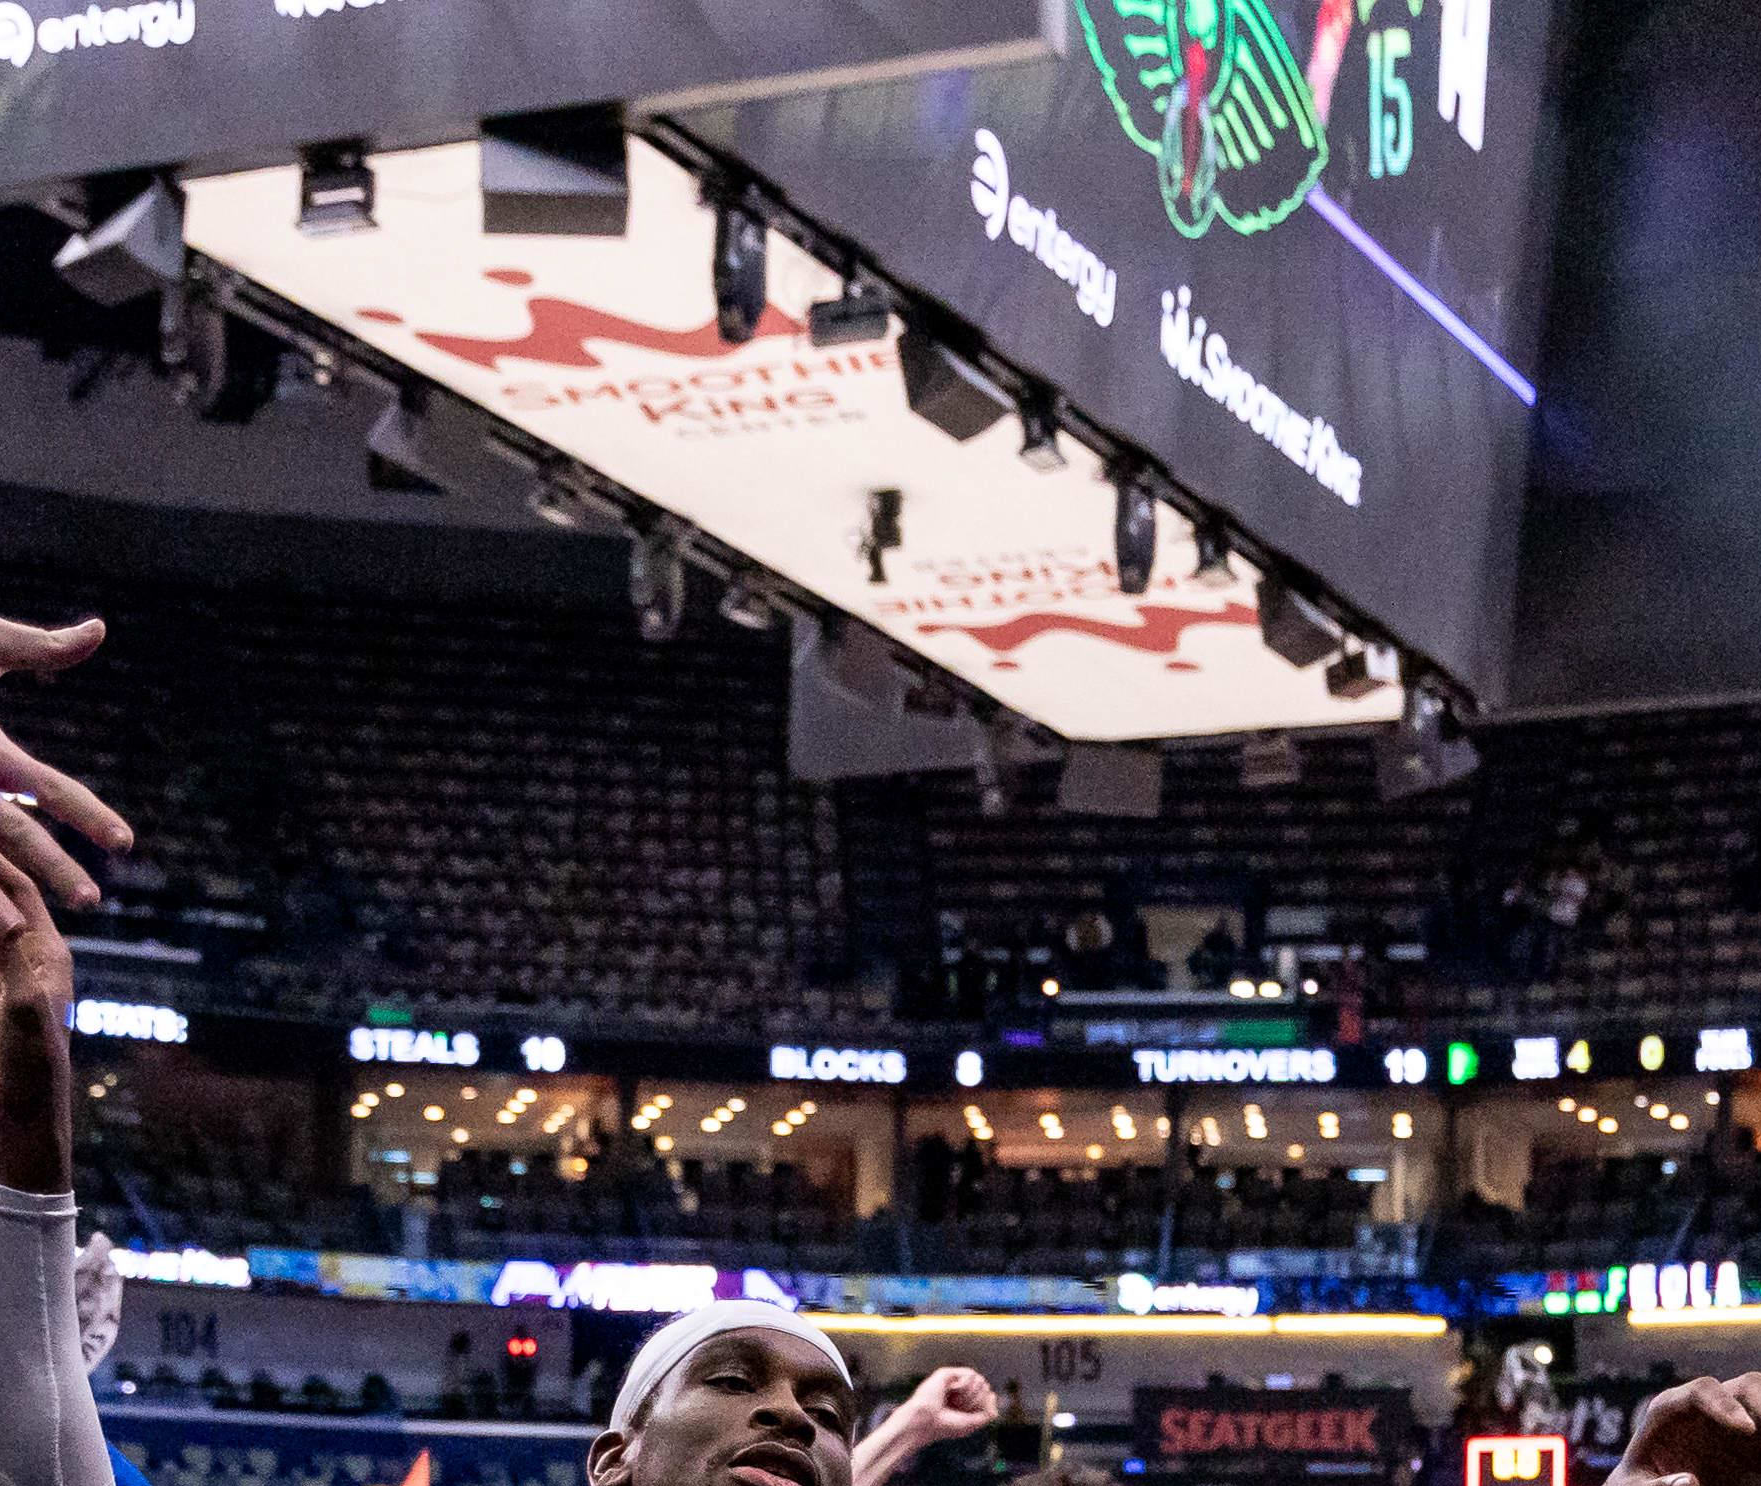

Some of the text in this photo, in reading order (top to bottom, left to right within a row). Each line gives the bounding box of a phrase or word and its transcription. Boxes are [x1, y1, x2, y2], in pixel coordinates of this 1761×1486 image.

[1366, 26, 1414, 179] 15
[1007, 193, 1117, 328] entergy
[350, 1027, 480, 1066] STEALS
[770, 1045, 906, 1083] BLOCKS
[1133, 1049, 1336, 1084] TURNOVERS
[1040, 1339, 1102, 1382] 105
